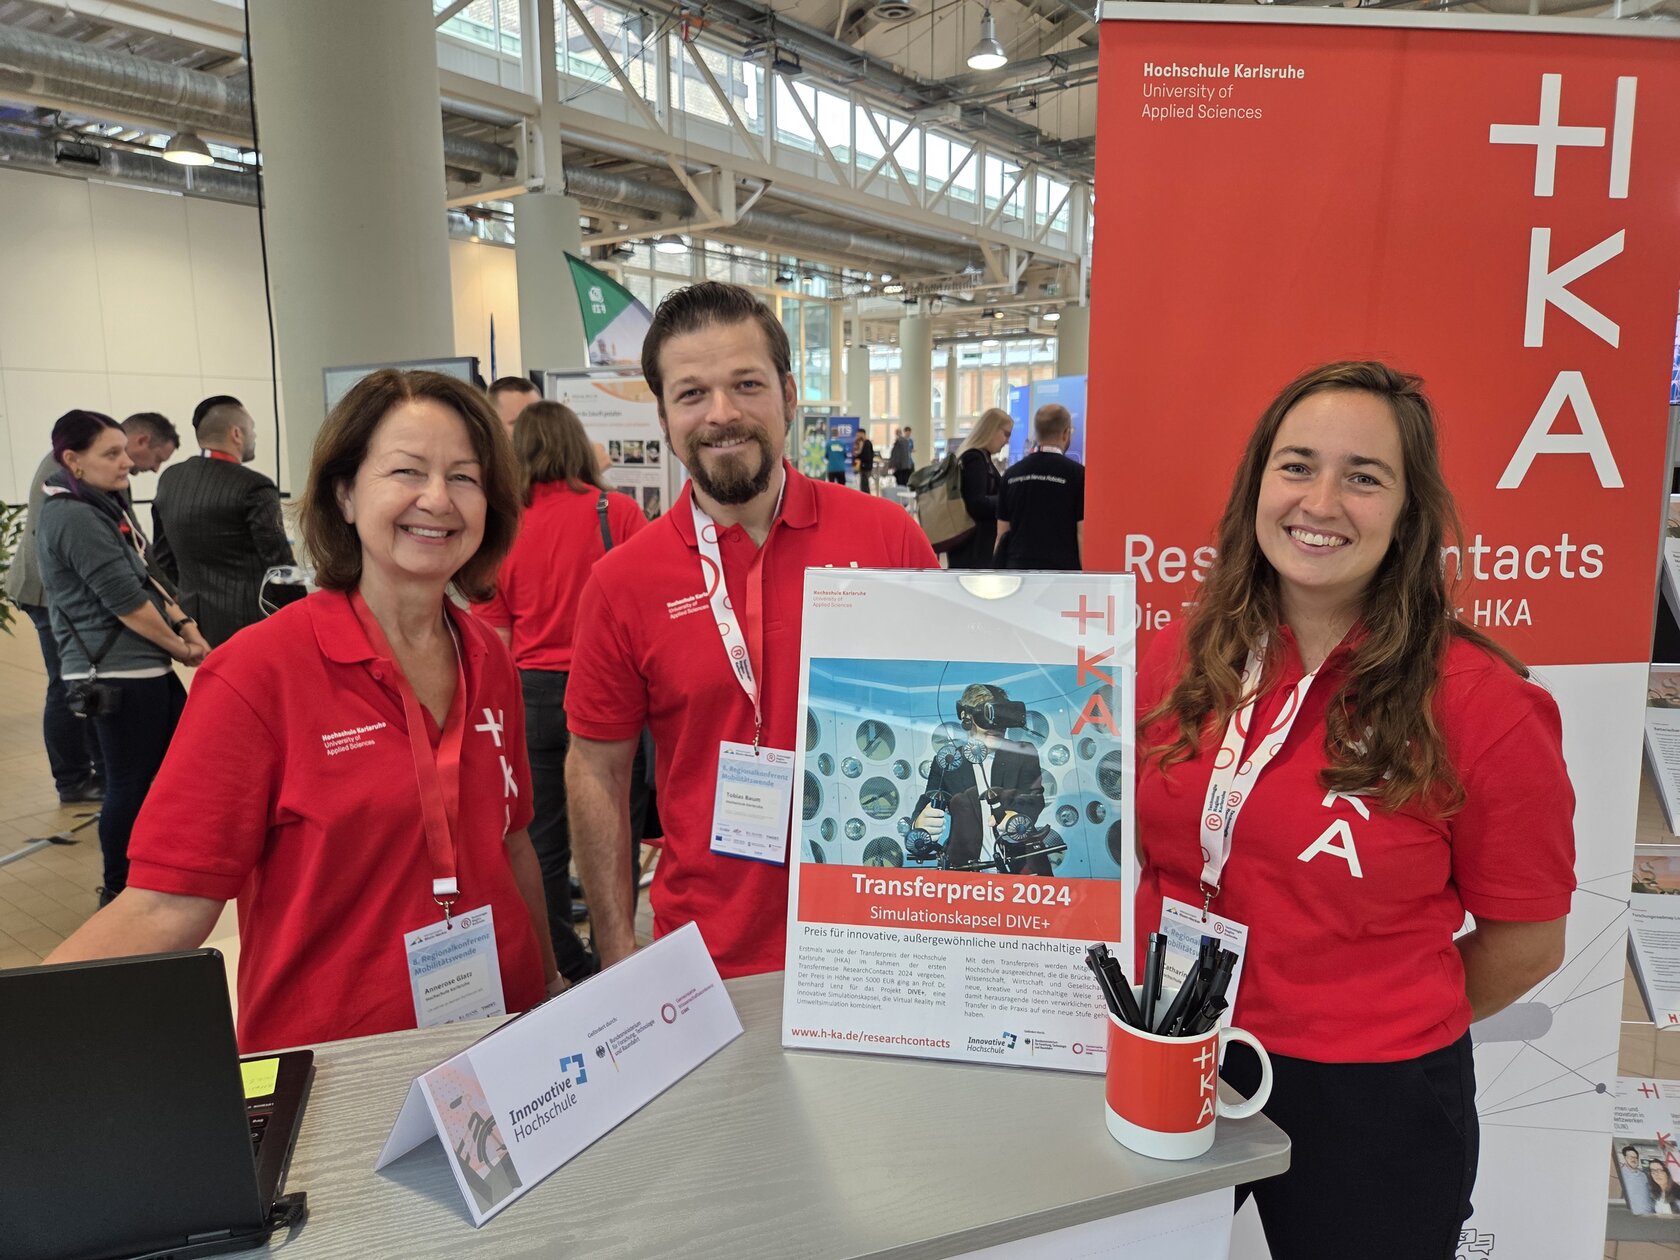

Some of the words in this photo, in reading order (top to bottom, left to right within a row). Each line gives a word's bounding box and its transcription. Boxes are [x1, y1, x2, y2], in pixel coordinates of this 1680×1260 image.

[1143, 63, 1230, 78] Hochschule
[1234, 64, 1305, 79] Karlsruhe
[1143, 83, 1215, 101] University
[1218, 84, 1234, 98] of
[1141, 104, 1194, 121] Applied
[1197, 104, 1263, 119] Sciences
[1473, 599, 1532, 627] HKA
[322, 728, 357, 741] Hochschule
[356, 721, 387, 733] Karlsruhe
[324, 736, 354, 749] University
[327, 743, 349, 756] Applied
[350, 739, 375, 750] Sciences
[852, 872, 1005, 905] Transferpreis
[1012, 883, 1071, 906] 2024
[870, 906, 1001, 928] Simulationskapsel
[1006, 915, 1050, 930] DIVE+
[421, 933, 490, 963] Regionalkonferenz
[804, 926, 827, 937] Preis
[830, 927, 845, 938] für
[847, 928, 900, 943] innovative,
[903, 932, 996, 948] außergewöhnliche
[998, 938, 1018, 949] und
[1021, 941, 1081, 955] nachhaltige
[414, 948, 477, 976] Mobilitätswende
[799, 954, 825, 962] Karlsruhe
[834, 956, 851, 965] (HKA)
[876, 959, 900, 967] Rahmen
[909, 961, 919, 969] der
[860, 949, 897, 959] Transferpreis
[913, 953, 947, 961] Hochschule
[1001, 959, 1039, 968] Transferpreis
[810, 972, 825, 980] Preis
[865, 976, 881, 984] 5000
[896, 979, 910, 987] ging
[965, 966, 1000, 974] Hochschule
[1001, 969, 1046, 978] ausgezeichnet,
[1070, 973, 1091, 981] Brücke
[425, 977, 456, 995] Annerose
[456, 971, 473, 982] Glatz
[797, 981, 825, 989] Bernhard
[880, 986, 901, 995] Projekt
[1012, 978, 1044, 986] Wirtschaft
[1067, 982, 1101, 991] Gesellscha
[986, 985, 1011, 993] kreative
[1032, 989, 1068, 998] nachhaltige
[1072, 991, 1092, 999] Weise
[894, 996, 913, 1004] Virtual
[914, 997, 934, 1006] Reality
[965, 1001, 989, 1010] Transfer
[1010, 1005, 1028, 1013] Praxis
[1030, 1006, 1040, 1014] auf
[1075, 1010, 1092, 1018] Stufe
[984, 994, 1029, 1004] herausragende
[1031, 996, 1049, 1004] Ideen
[1050, 999, 1092, 1008] verwirklichen
[791, 1028, 950, 1048] www.h-ka.de/researchcontacts
[968, 1036, 1005, 1046] Innovative
[966, 1044, 1005, 1054] Hochschule
[1193, 1041, 1215, 1124] HKA
[509, 1077, 572, 1126] Innovative
[513, 1092, 578, 1143] Hochschule
